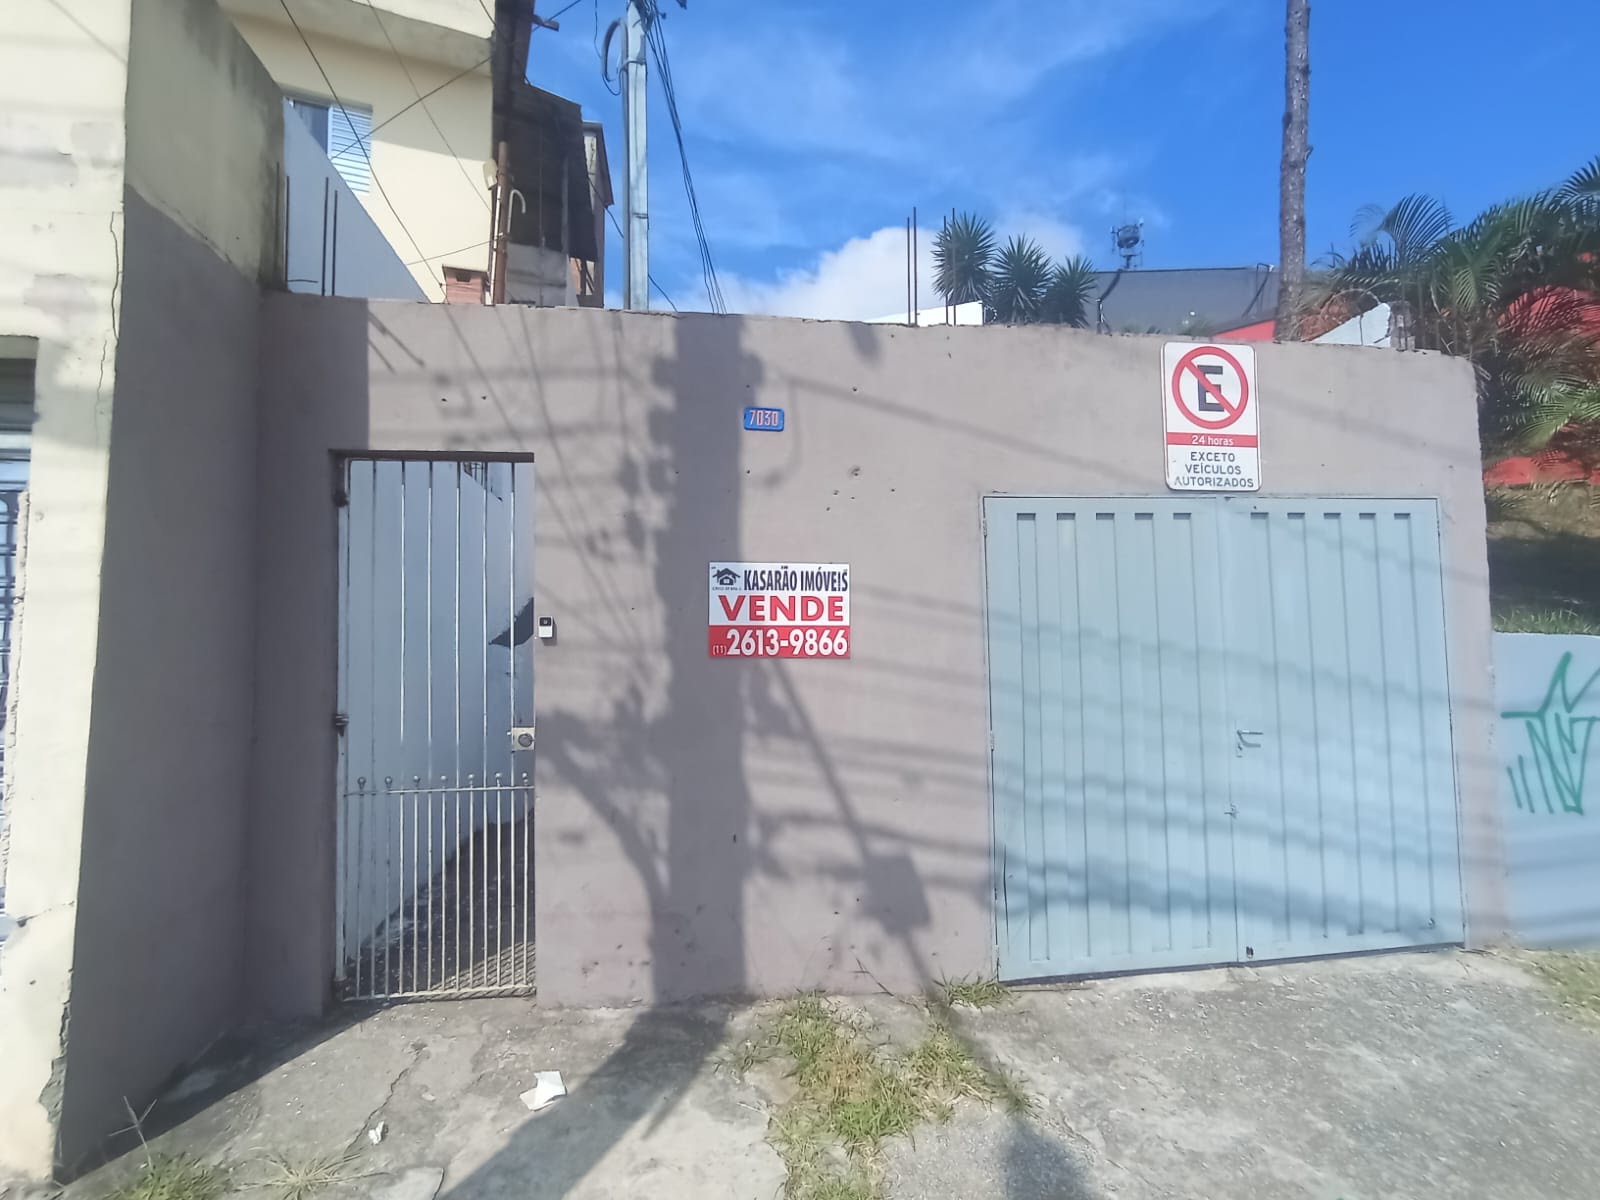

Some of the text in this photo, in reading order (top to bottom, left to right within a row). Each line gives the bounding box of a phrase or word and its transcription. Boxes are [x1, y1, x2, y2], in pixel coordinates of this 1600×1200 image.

[1197, 364, 1225, 412] E
[749, 410, 778, 426] 7030
[1191, 434, 1234, 446] 24 horas
[1190, 451, 1236, 462] EXCETO
[1184, 463, 1242, 475] VEÍCULOS
[1174, 476, 1254, 488] AUTORIZADOS
[743, 565, 848, 592] KASARÃO IMÓVEIS
[718, 595, 844, 621] VENDE
[726, 628, 848, 656] 2613-9866
